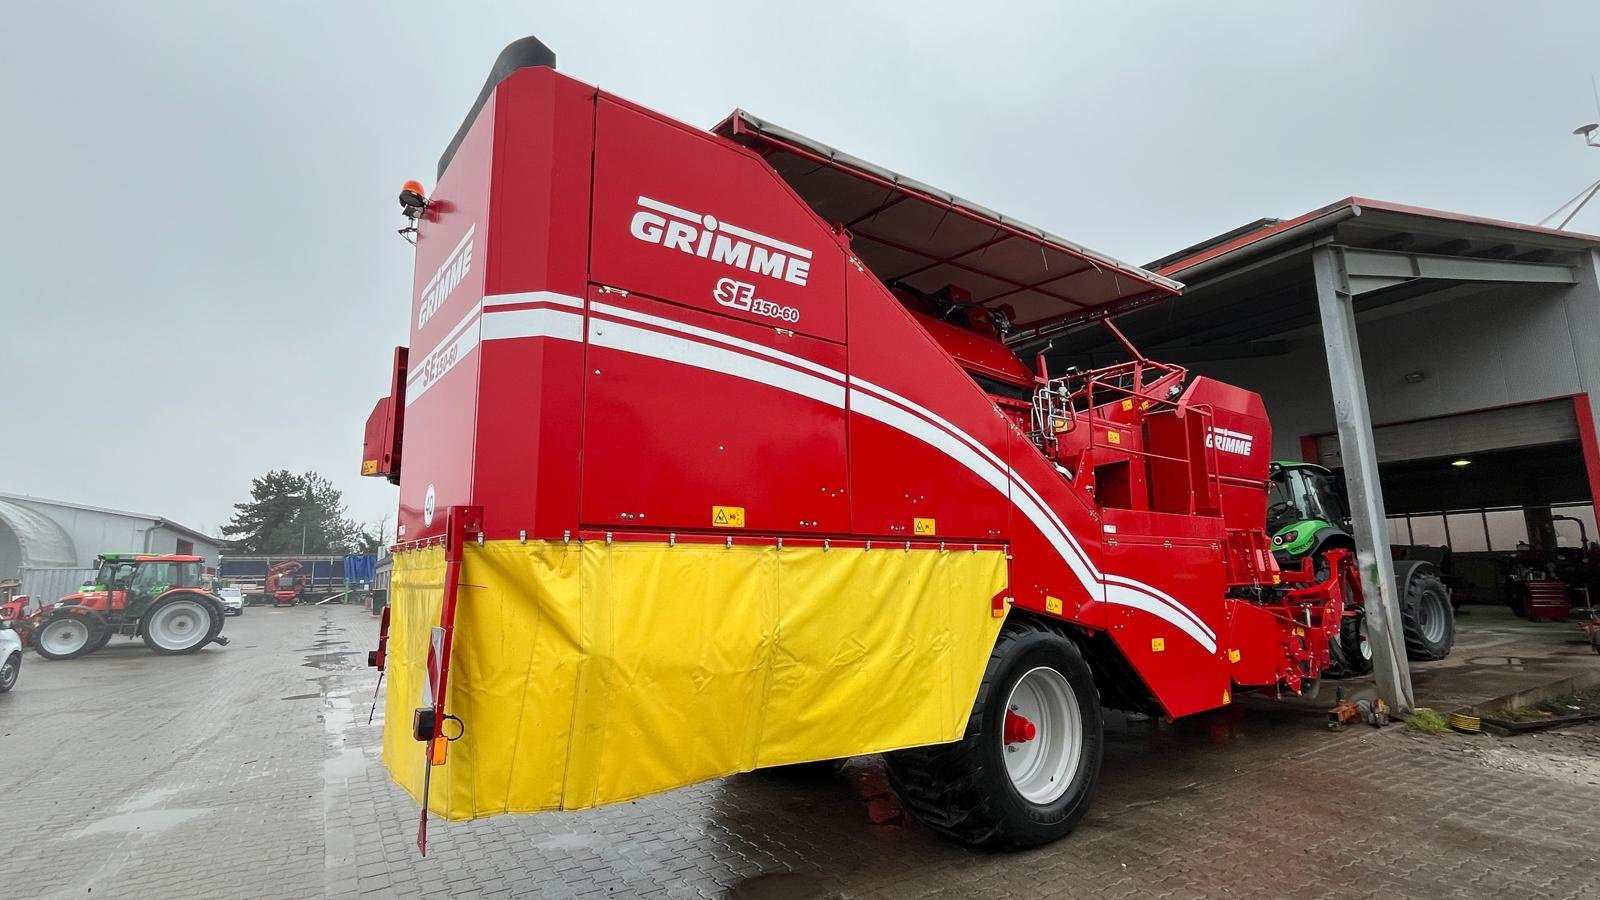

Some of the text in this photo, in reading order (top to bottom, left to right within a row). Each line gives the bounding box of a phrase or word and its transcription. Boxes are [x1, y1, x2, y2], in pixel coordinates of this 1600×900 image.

[630, 211, 811, 287] GRIMME
[418, 239, 474, 331] GRIMME
[716, 280, 799, 322] SE 150-60
[423, 352, 437, 387] SE
[1206, 428, 1252, 456] GRIMME
